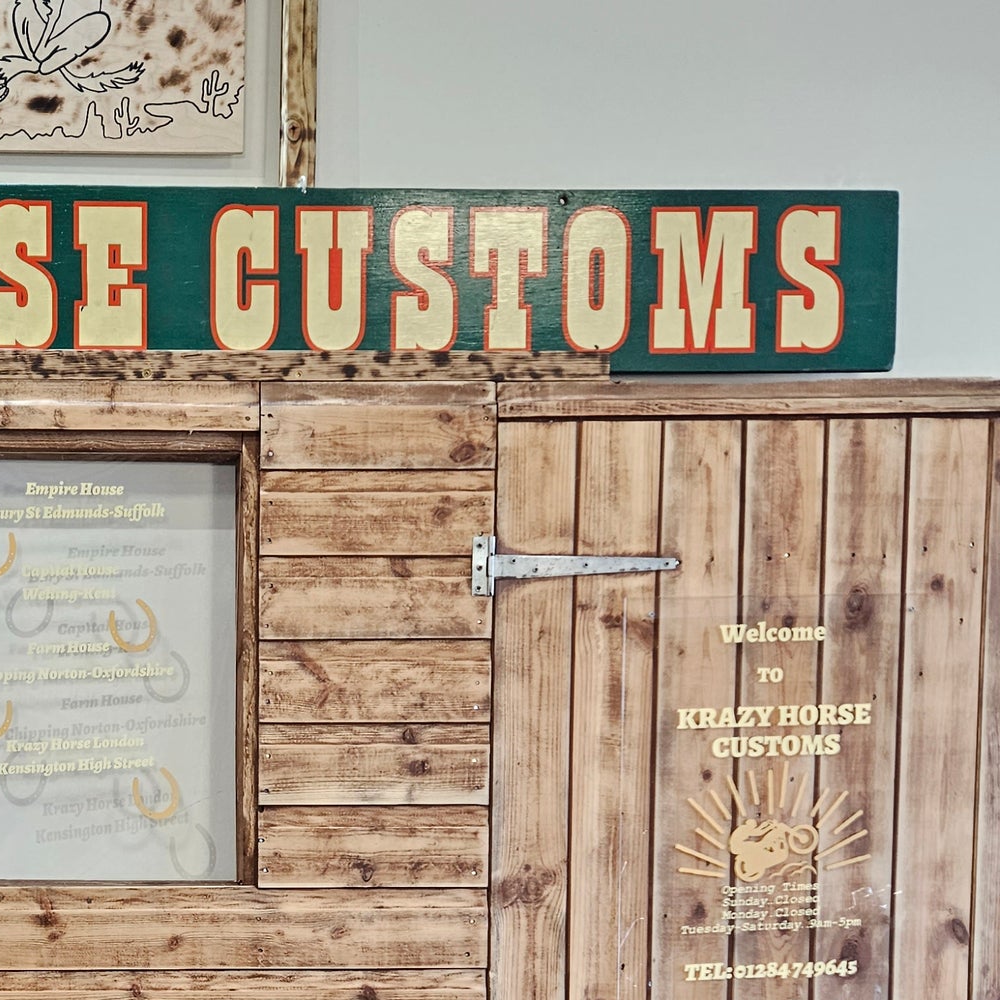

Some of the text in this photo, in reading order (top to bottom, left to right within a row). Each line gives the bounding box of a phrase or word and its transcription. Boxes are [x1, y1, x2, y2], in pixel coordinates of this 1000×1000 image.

[210, 203, 845, 355] CUSTOMS
[25, 481, 124, 499] Empire House
[26, 505, 41, 519] St
[42, 503, 165, 522] Edmunds-Suffolk
[720, 622, 826, 643] Welcome
[37, 665, 175, 681] Norton-Oxfordshire
[757, 667, 784, 683] TO
[677, 703, 872, 729] KRAZY HORSE
[6, 735, 144, 754] Krazy Horse London
[712, 734, 841, 758] CUSTOMS
[77, 757, 112, 773] High
[114, 756, 154, 770] Street
[720, 882, 820, 897] Opening Times
